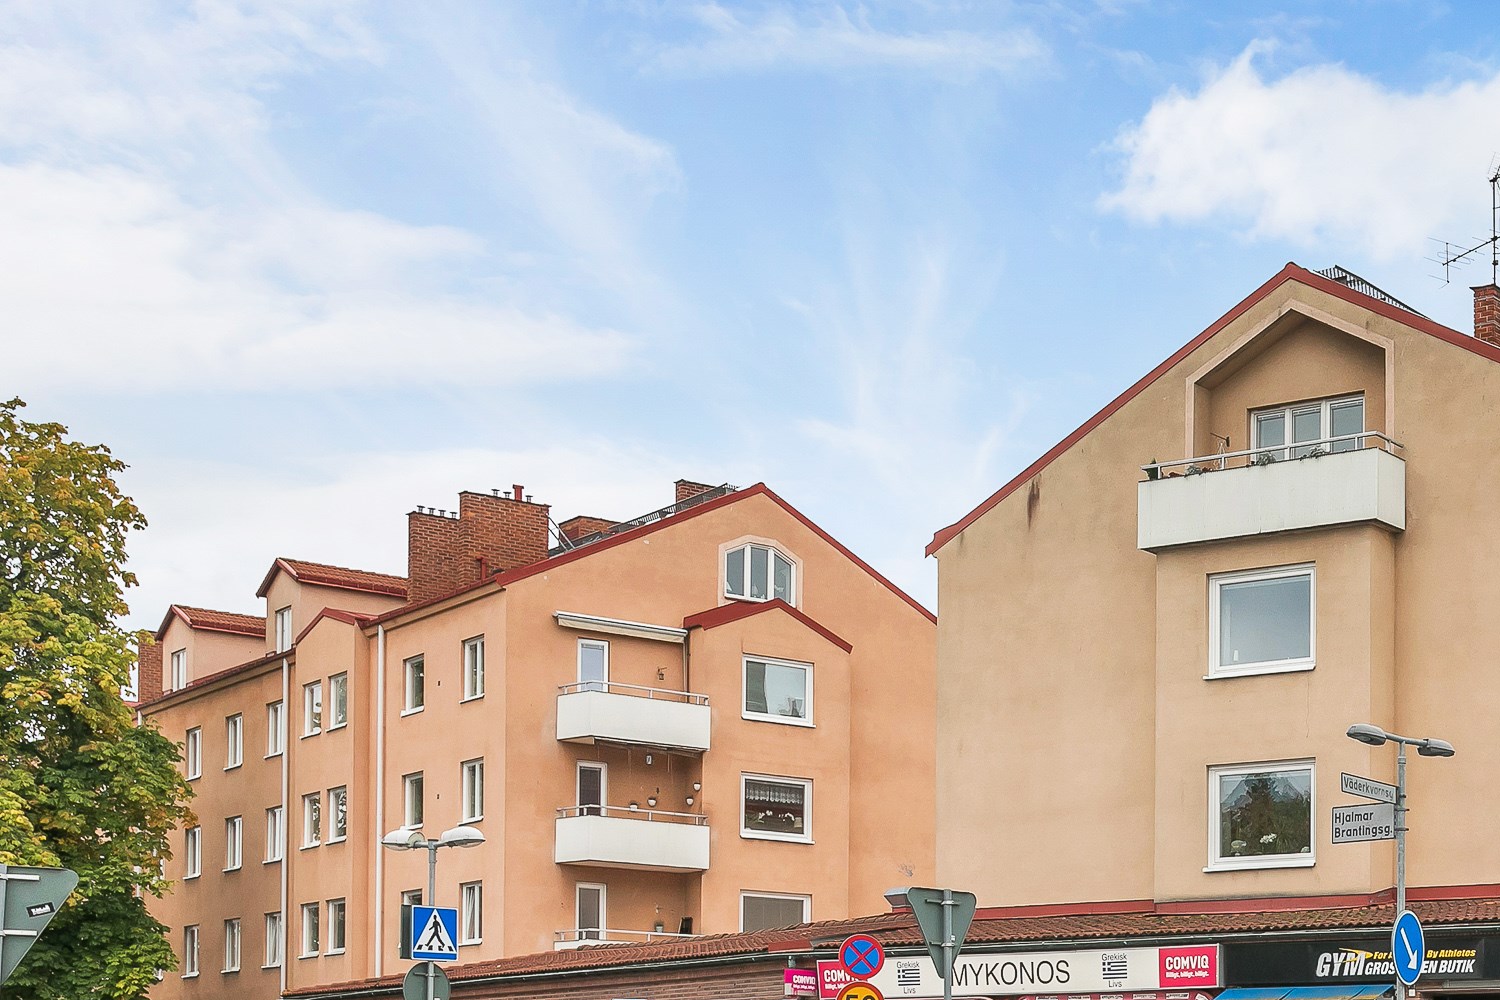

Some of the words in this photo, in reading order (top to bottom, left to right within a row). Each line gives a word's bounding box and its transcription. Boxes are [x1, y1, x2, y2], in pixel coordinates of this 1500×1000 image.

[1334, 812, 1374, 825] Hjalmar
[1334, 825, 1392, 838] Brantingsg.
[1102, 953, 1127, 961] Grekisk
[1373, 951, 1387, 959] For
[1426, 950, 1438, 959] By
[1166, 955, 1209, 970] COMVIQ
[1316, 952, 1366, 977] GYM
[1365, 960, 1438, 975] GROSEN
[1438, 960, 1475, 974] BUTIK
[824, 969, 858, 982] COMV
[952, 960, 1070, 986] MYKONOS
